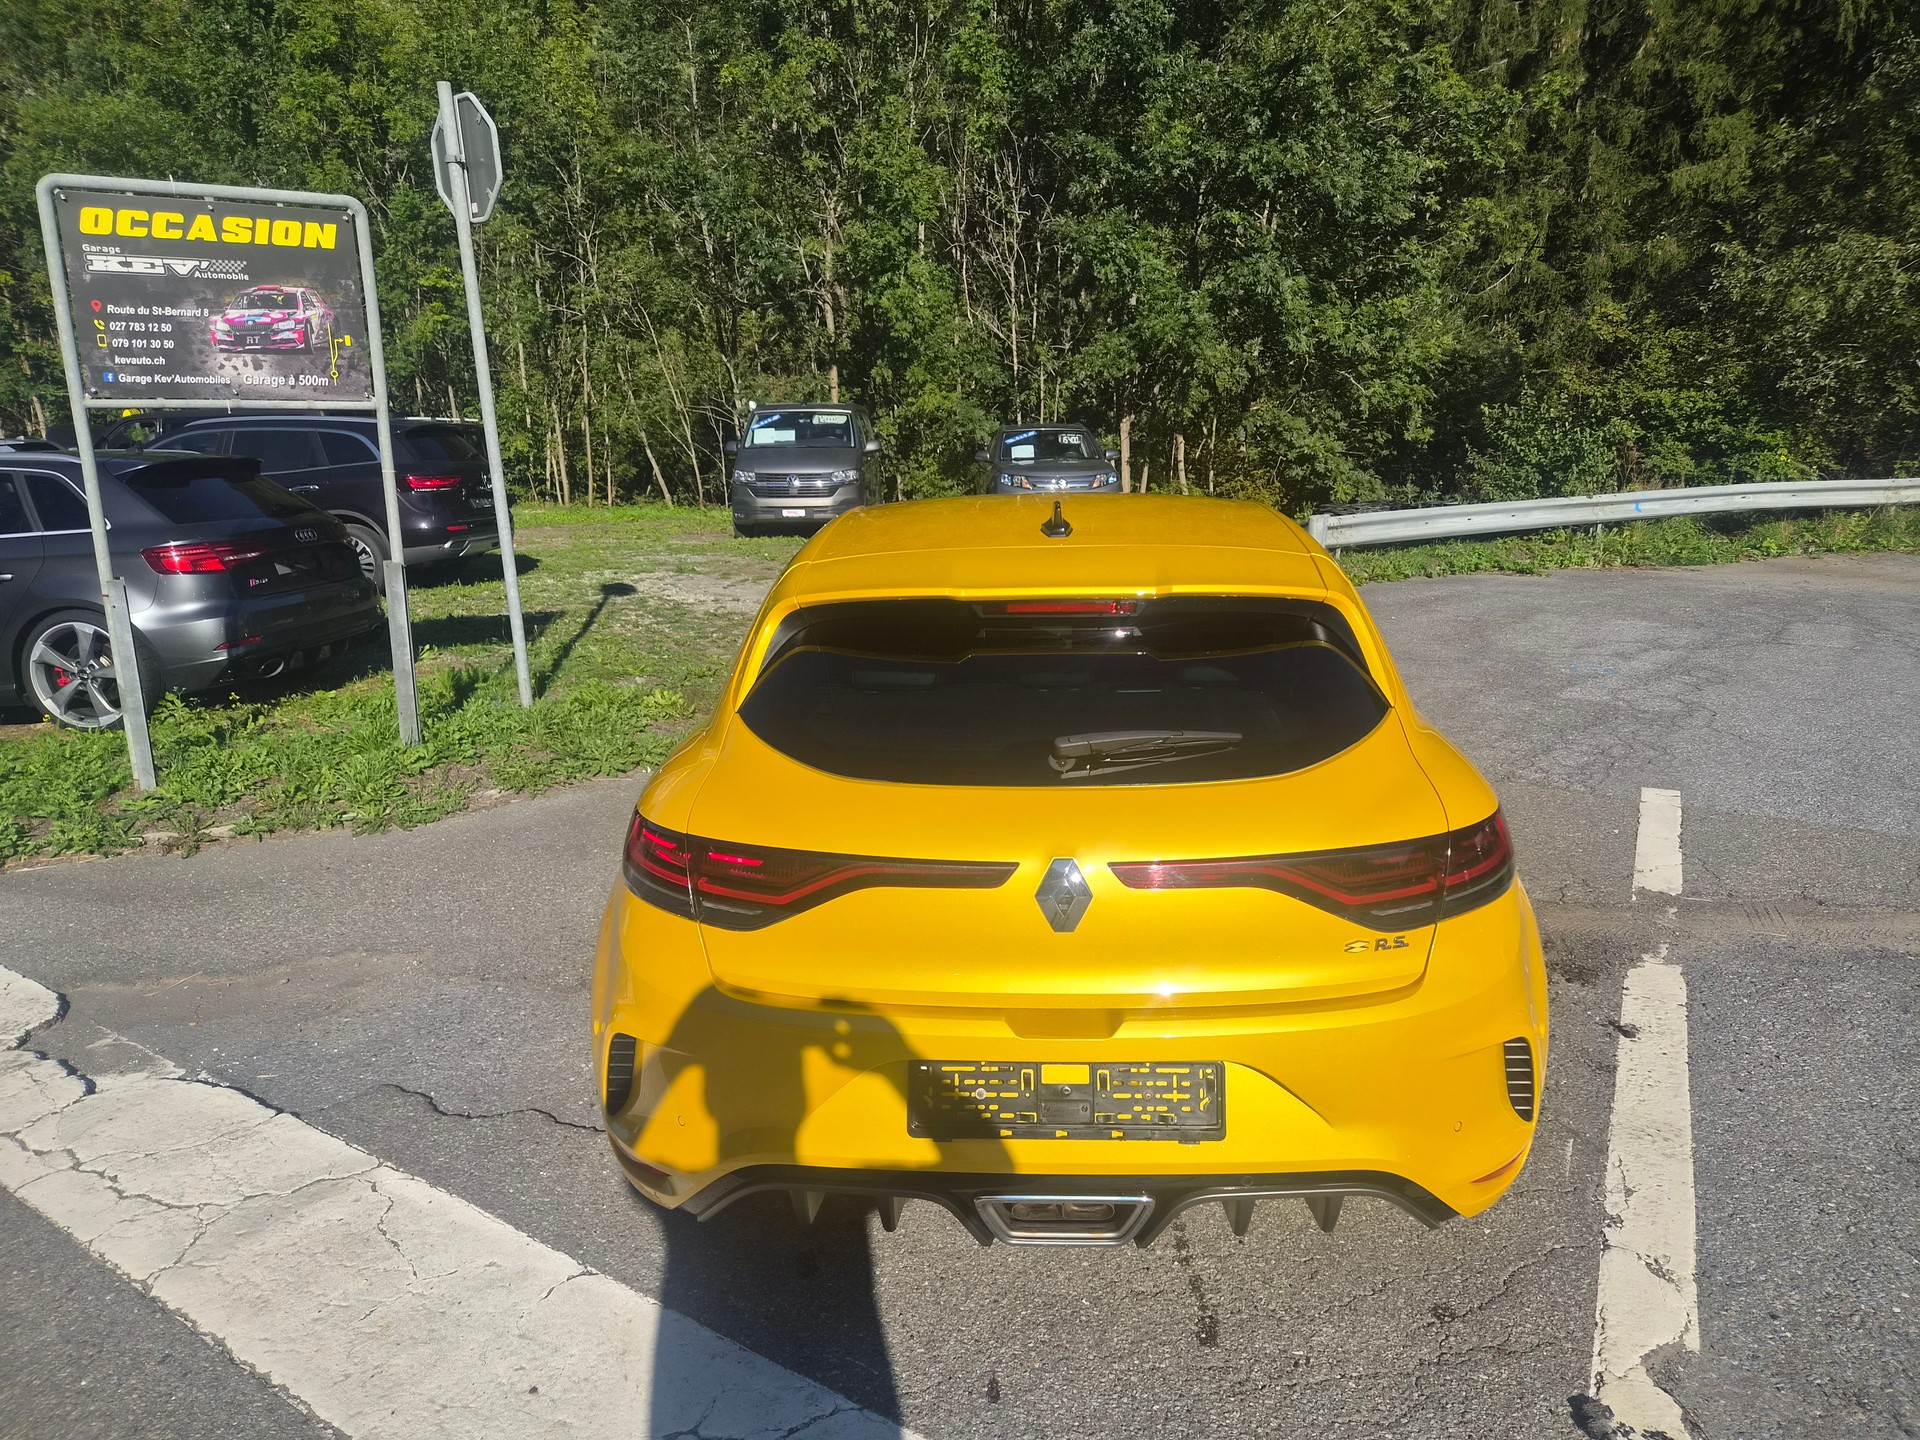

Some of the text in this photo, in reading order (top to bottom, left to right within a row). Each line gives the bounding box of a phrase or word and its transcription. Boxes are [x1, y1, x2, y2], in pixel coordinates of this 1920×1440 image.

[79, 206, 337, 249] OCCASION
[82, 244, 121, 254] Garage
[194, 271, 249, 281] Automobile
[107, 305, 209, 317] Route du St-Bernard 8
[109, 322, 172, 332] 027 783 12 50
[112, 339, 174, 349] 079 101 30 50
[115, 355, 165, 365] kevauto.ch
[118, 373, 152, 384] Garage
[243, 374, 329, 387] Garage à 500m
[1374, 935, 1409, 951] R.S.
